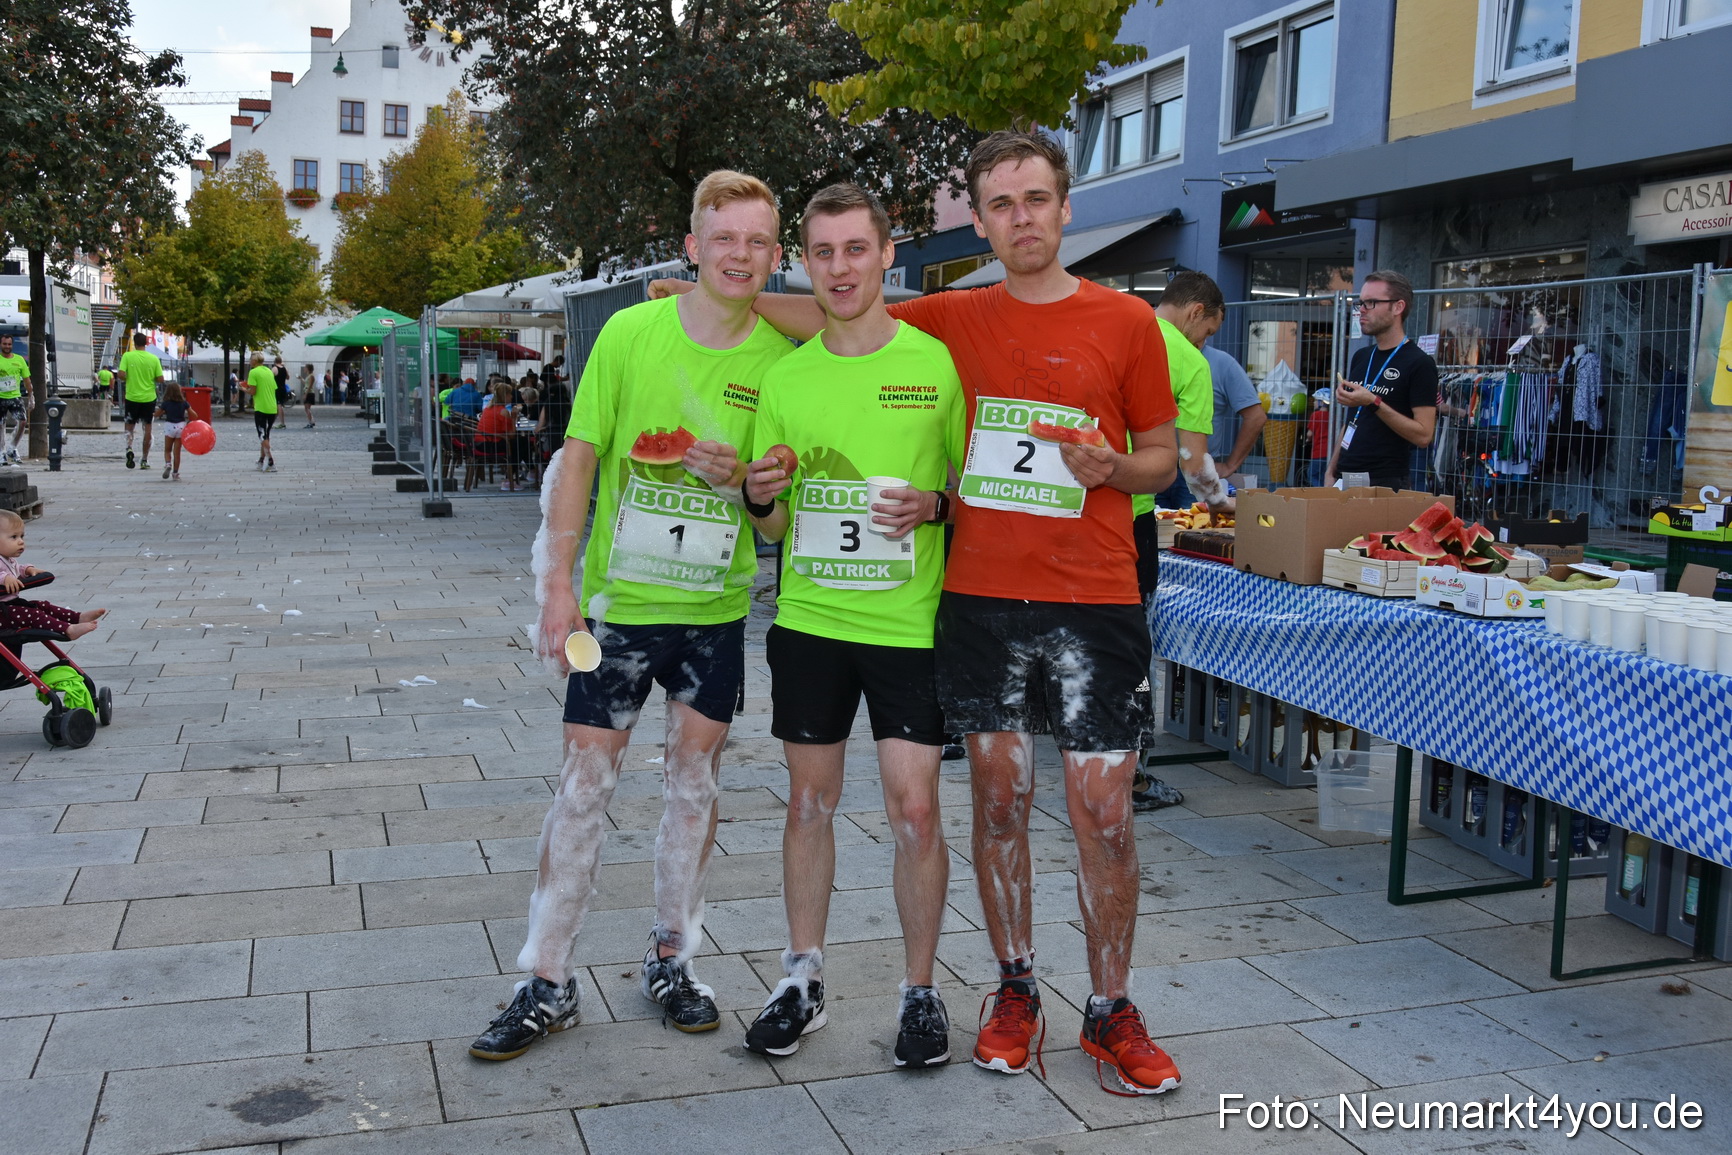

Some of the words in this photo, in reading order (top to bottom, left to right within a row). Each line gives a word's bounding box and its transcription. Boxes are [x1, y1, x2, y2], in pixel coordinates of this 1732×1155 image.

[1663, 180, 1732, 213] CASA
[878, 394, 939, 402] ELEMENTELAUF
[881, 385, 937, 393] NEUMARKTER
[1013, 440, 1036, 474] 2
[630, 484, 731, 522] BOCK
[803, 484, 867, 510] BOC
[979, 481, 1062, 504] MICHAEL
[1682, 517, 1692, 527] Hu
[668, 524, 686, 554] 1
[839, 520, 861, 553] 3
[812, 562, 891, 578] PATRICK
